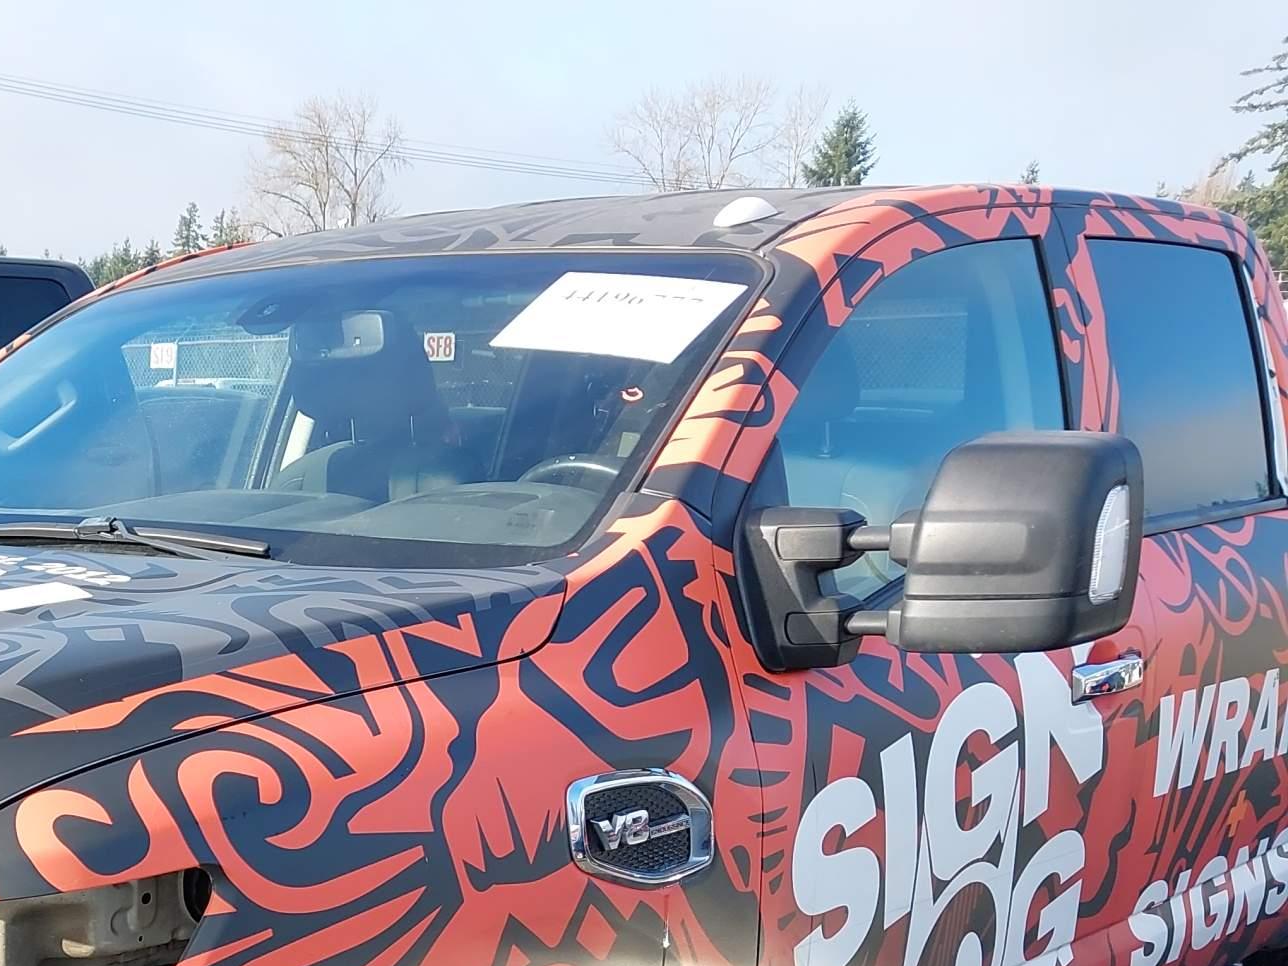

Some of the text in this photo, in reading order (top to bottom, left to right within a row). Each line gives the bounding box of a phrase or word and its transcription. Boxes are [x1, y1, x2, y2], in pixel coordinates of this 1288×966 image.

[427, 335, 453, 358] SF8
[21, 562, 132, 587] 2012
[1153, 667, 1288, 798] WRA
[589, 810, 650, 851] V8
